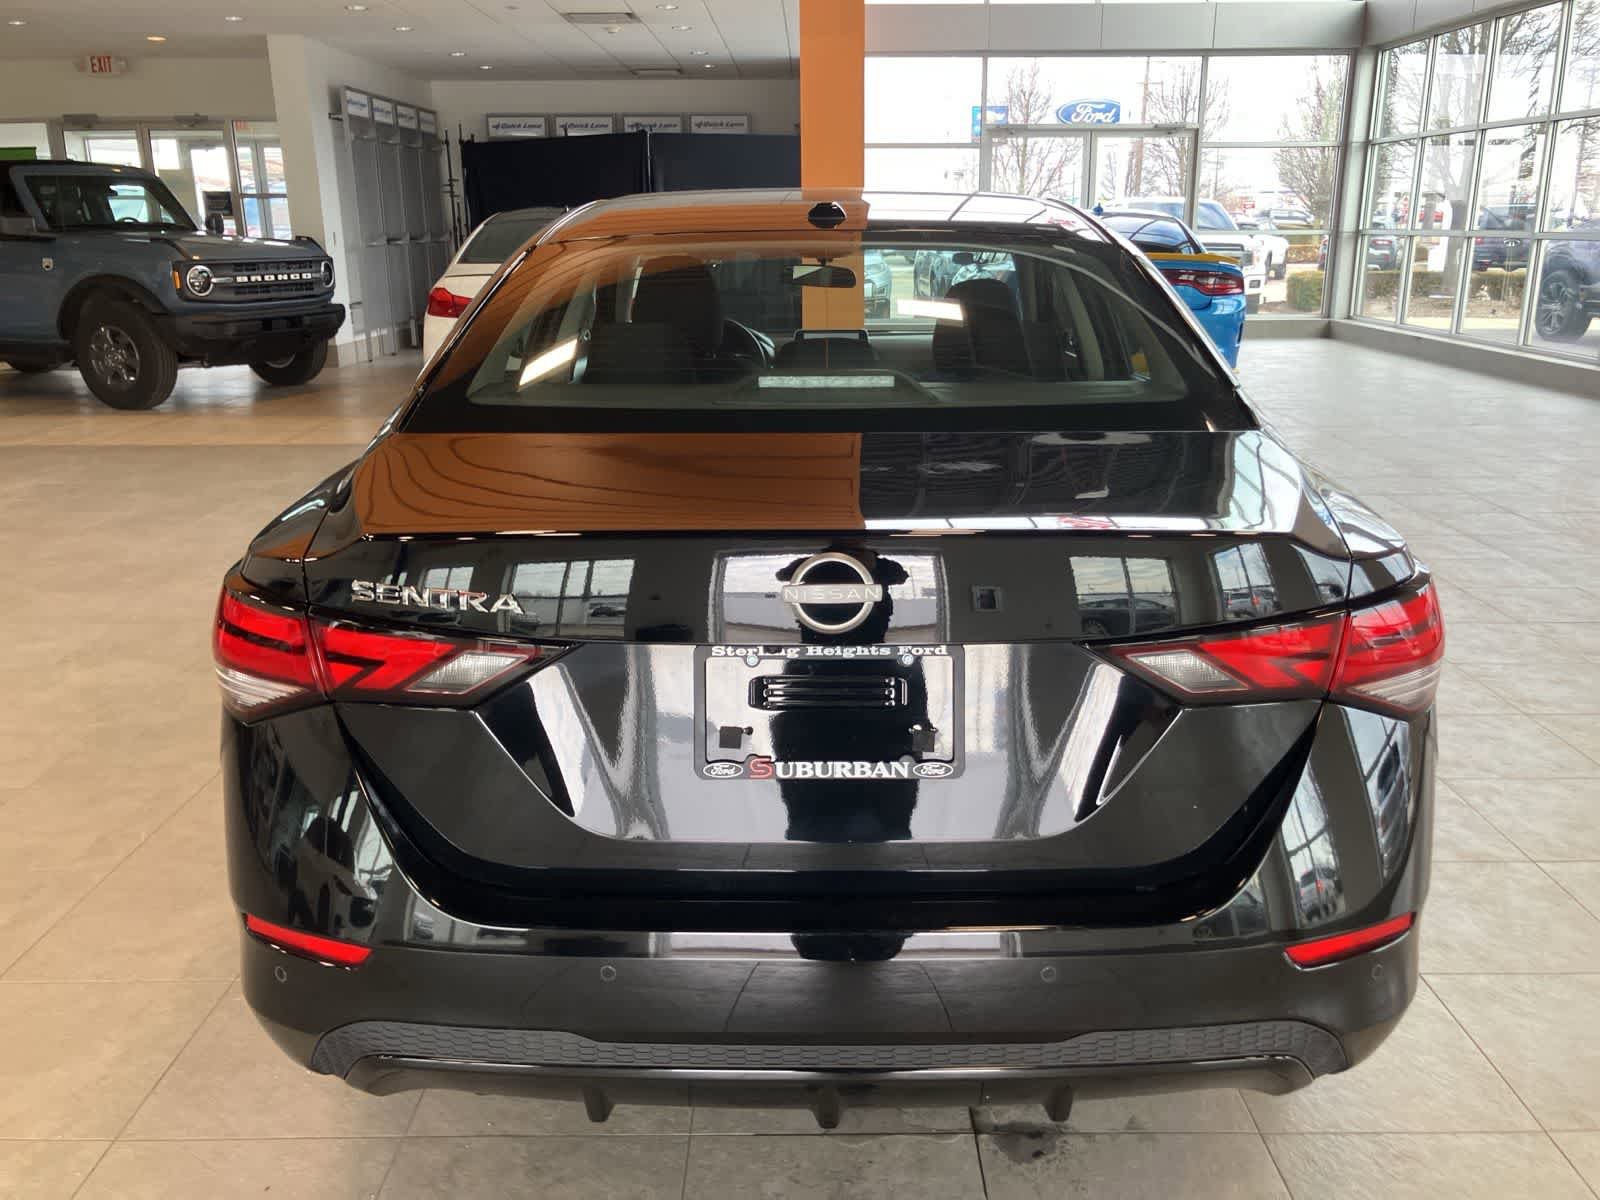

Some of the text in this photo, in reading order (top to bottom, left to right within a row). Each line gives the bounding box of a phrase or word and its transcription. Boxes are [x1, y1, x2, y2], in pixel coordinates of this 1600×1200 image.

[90, 55, 112, 73] EXIT
[1071, 102, 1118, 123] Ford
[236, 272, 312, 283] BRONCO
[351, 578, 526, 615] SENTRA
[783, 587, 880, 601] NISSAN
[711, 645, 948, 659] Sterlg Heights Ford
[709, 763, 738, 776] Ford
[749, 757, 910, 779] SUBURBAN
[919, 763, 947, 776] Ford
